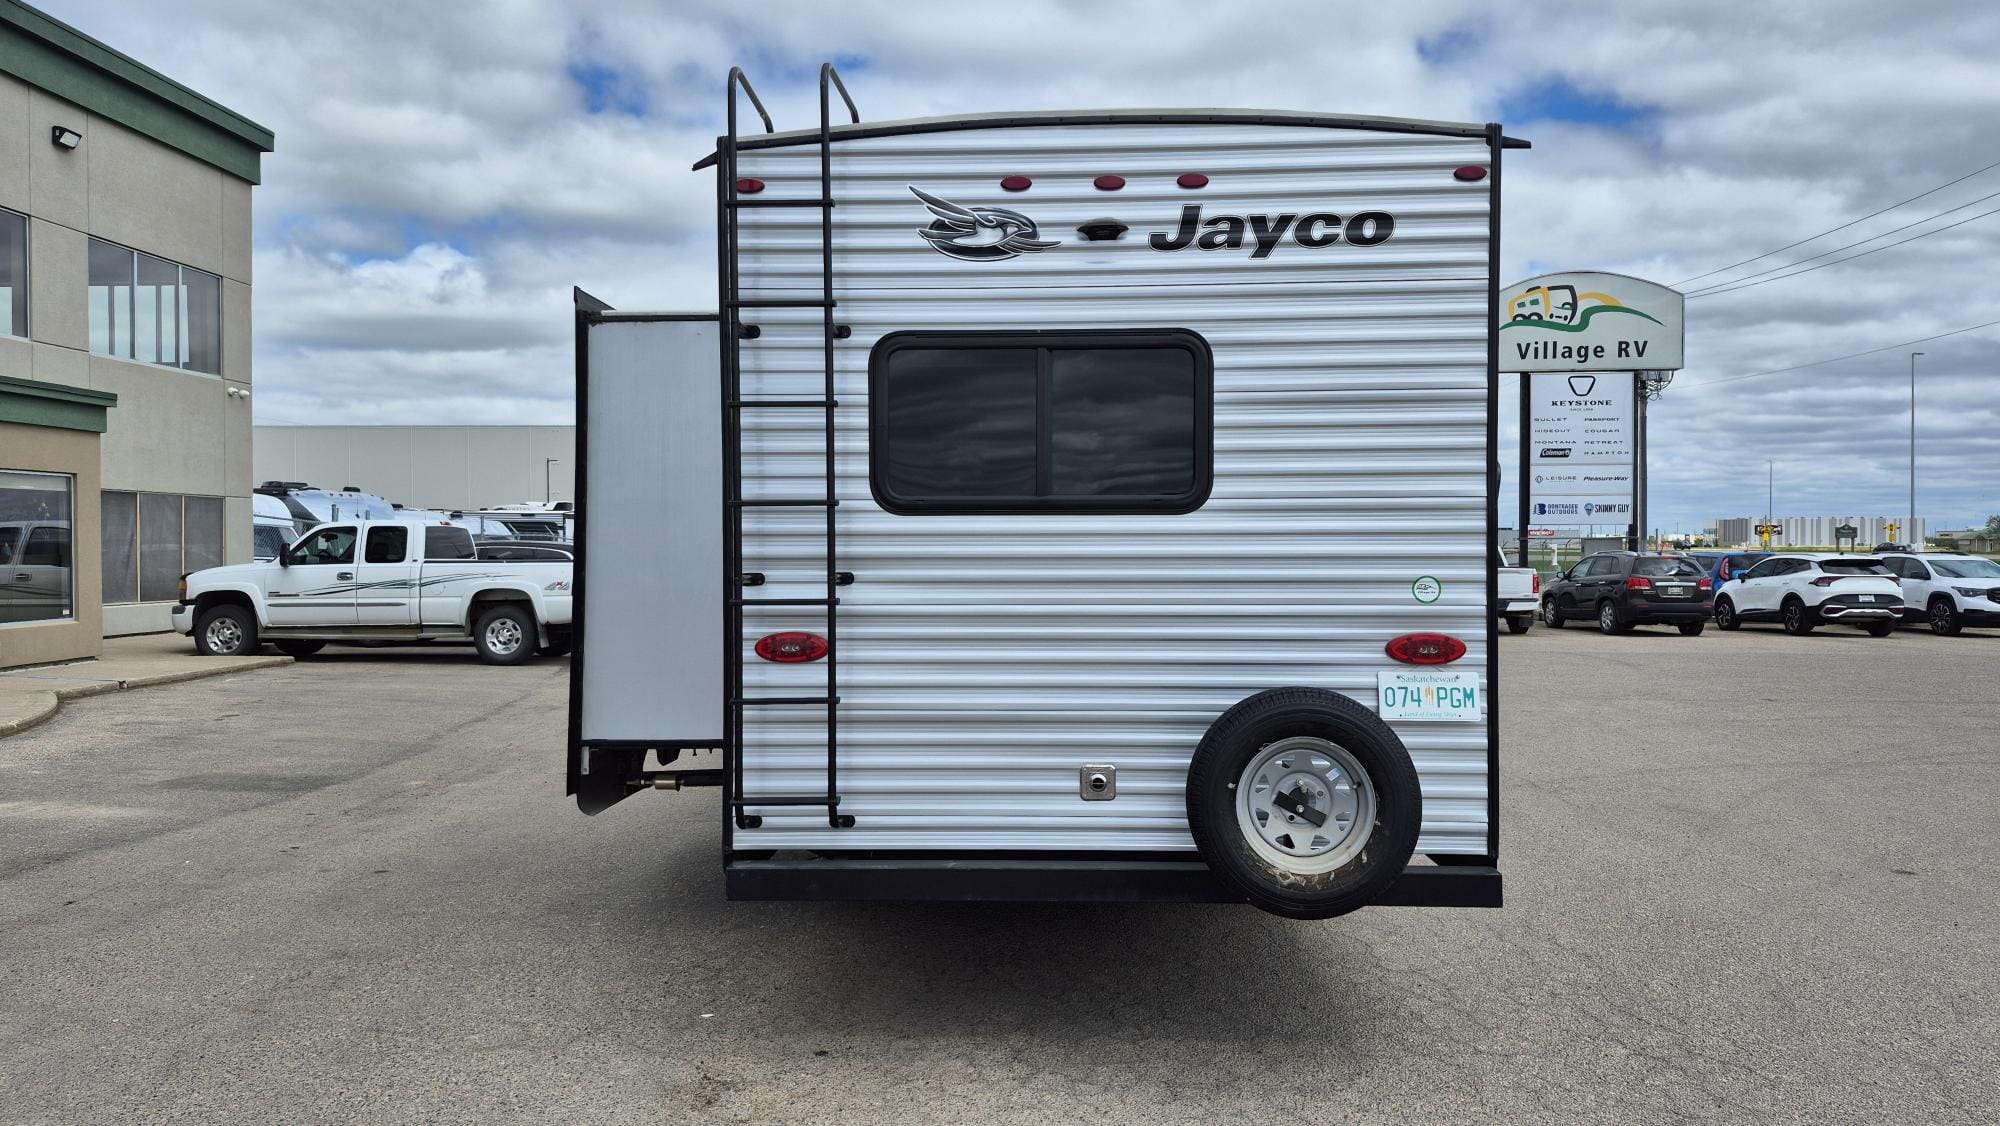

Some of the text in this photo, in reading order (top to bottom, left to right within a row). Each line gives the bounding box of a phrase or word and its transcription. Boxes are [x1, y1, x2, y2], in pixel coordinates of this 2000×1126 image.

[1149, 203, 1397, 260] Jayco
[1516, 340, 1649, 363] Village RV
[1542, 448, 1566, 456] Coleman
[1595, 503, 1630, 513] SKINNY GUY
[1400, 674, 1457, 683] Saskatchewan
[1384, 686, 1476, 708] 074 PGM
